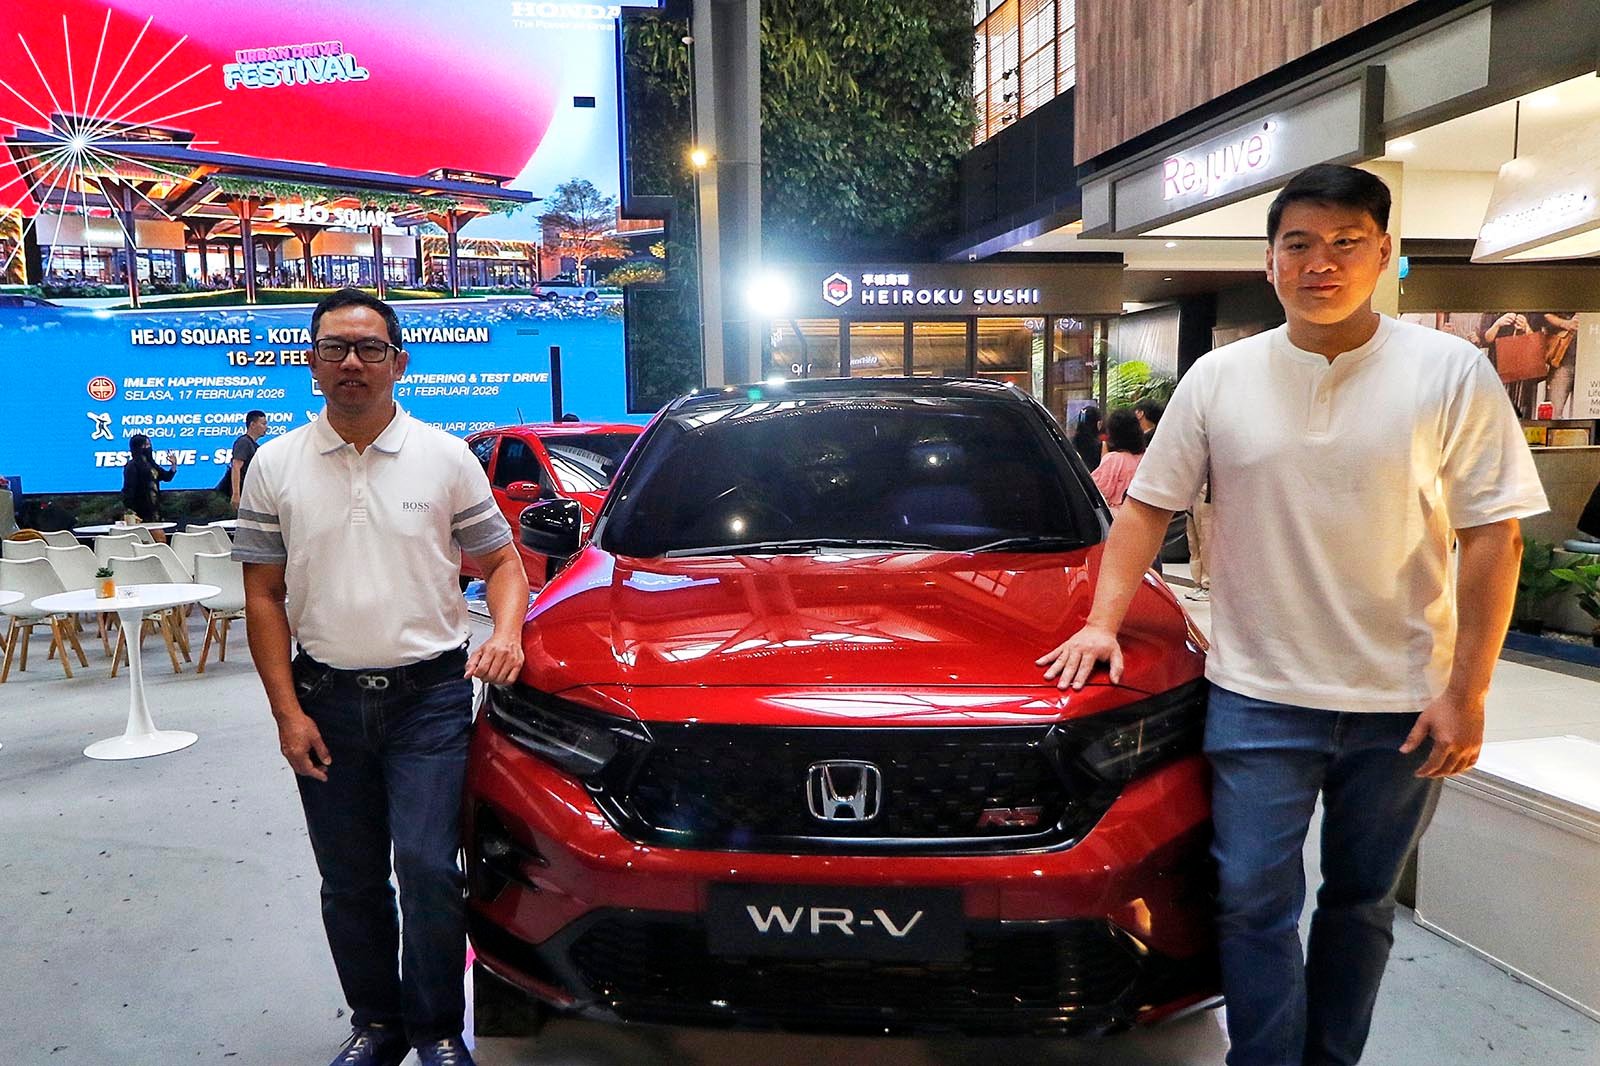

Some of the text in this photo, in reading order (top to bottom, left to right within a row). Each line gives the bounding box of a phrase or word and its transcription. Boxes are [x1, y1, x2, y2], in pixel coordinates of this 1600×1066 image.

[511, 2, 621, 19] HONDA
[237, 42, 342, 63] URBAN DRIVE
[224, 54, 369, 89] FESTIVAL
[273, 200, 396, 227] HEJO SQUARE
[861, 289, 1040, 305] HEIROKU SUSHI
[131, 329, 177, 345] HEJO
[181, 328, 251, 346] SQUARE
[268, 328, 313, 344] KOTA
[401, 327, 489, 343] AHYANGAN
[227, 350, 309, 366] 16-22 FEB
[123, 376, 267, 388] IMLEK HAPPINESSDAY
[468, 374, 478, 383] &
[480, 373, 511, 383] TEST
[512, 372, 549, 383] DRIVE
[124, 389, 286, 401] SELASA, 17 FEBRUARI 2026
[398, 386, 500, 397] 21 FEBRUARI 2026
[121, 414, 153, 426] KIDS
[155, 413, 202, 425] DANCE
[179, 426, 195, 437] 22
[402, 501, 430, 510] BOSS
[746, 905, 924, 938] WR-V
